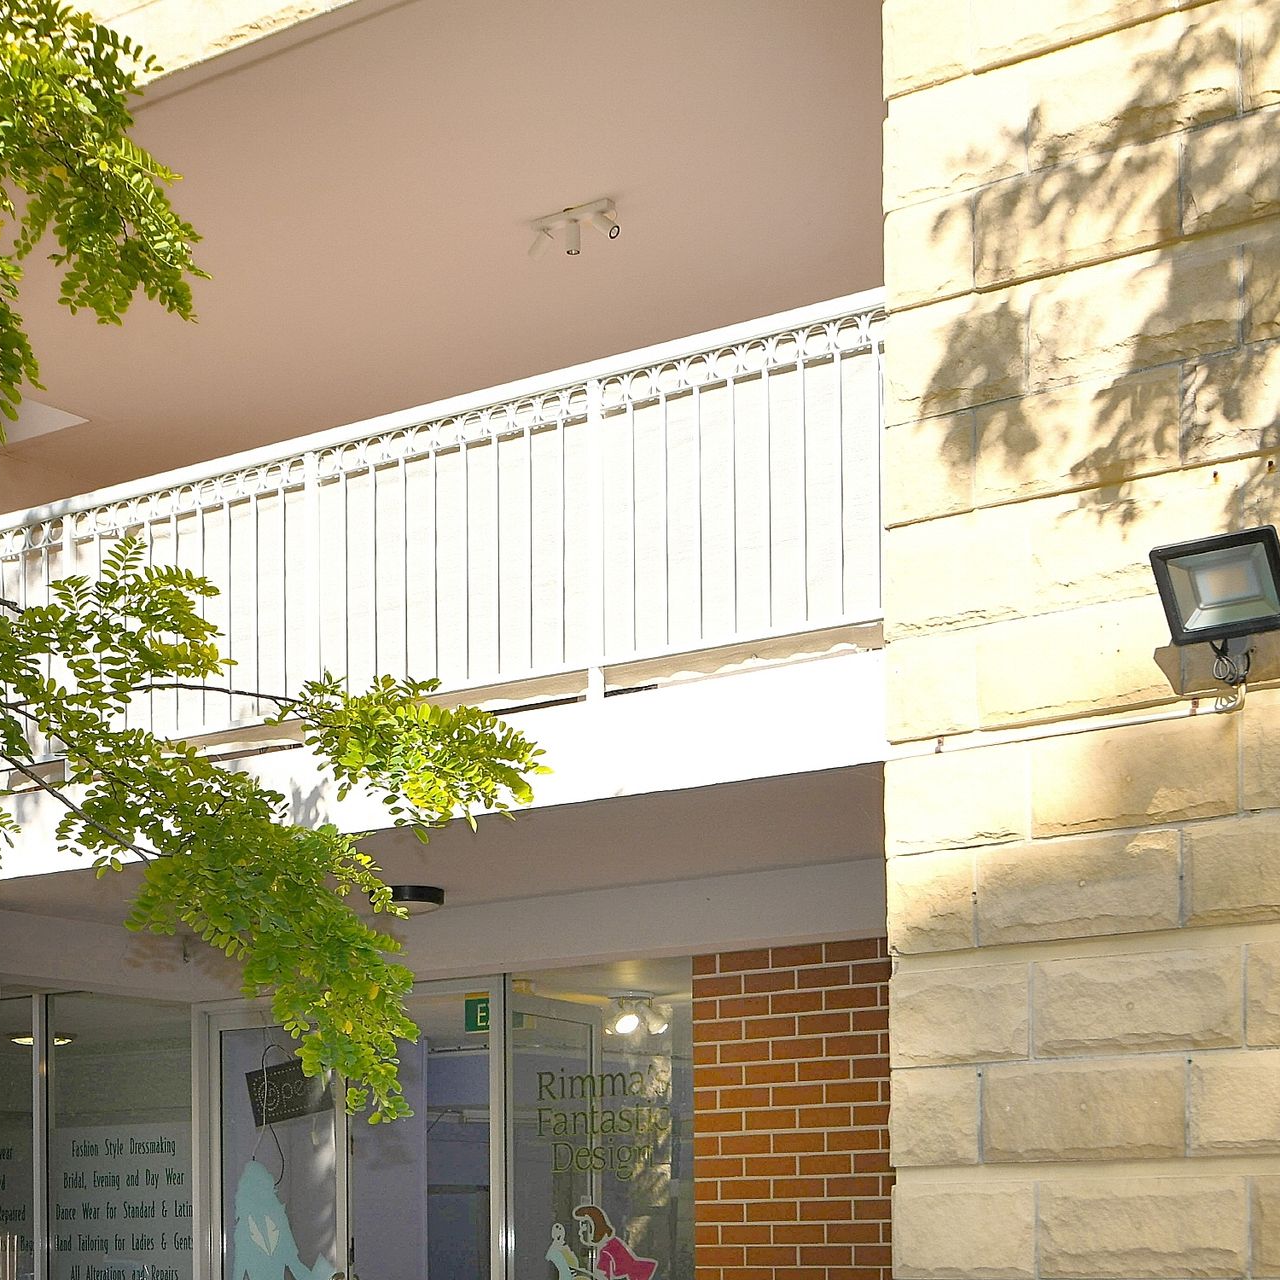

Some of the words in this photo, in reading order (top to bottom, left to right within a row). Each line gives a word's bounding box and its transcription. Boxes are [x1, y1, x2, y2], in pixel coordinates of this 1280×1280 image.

[258, 1079, 312, 1111] Ope
[536, 1100, 671, 1137] Fantastic
[72, 1140, 99, 1157] Fashion
[105, 1138, 124, 1159] Style
[129, 1136, 176, 1156] Dressmaking
[551, 1138, 655, 1180] Design
[63, 1171, 87, 1190] Bridal,
[93, 1170, 120, 1190] Evening
[126, 1169, 139, 1187] and
[145, 1169, 160, 1189] Day
[165, 1168, 185, 1185] Wear
[55, 1203, 76, 1221] Dance
[82, 1202, 100, 1220] Wear
[106, 1201, 118, 1220] for
[123, 1201, 156, 1219] Standard
[161, 1200, 168, 1218] &
[174, 1199, 193, 1218] Latin
[20, 1234, 35, 1256] Bag
[78, 1233, 109, 1254] Tailoring
[114, 1232, 126, 1251] for
[131, 1232, 155, 1251] Ladies
[161, 1232, 168, 1250] &
[131, 1264, 145, 1280] and
